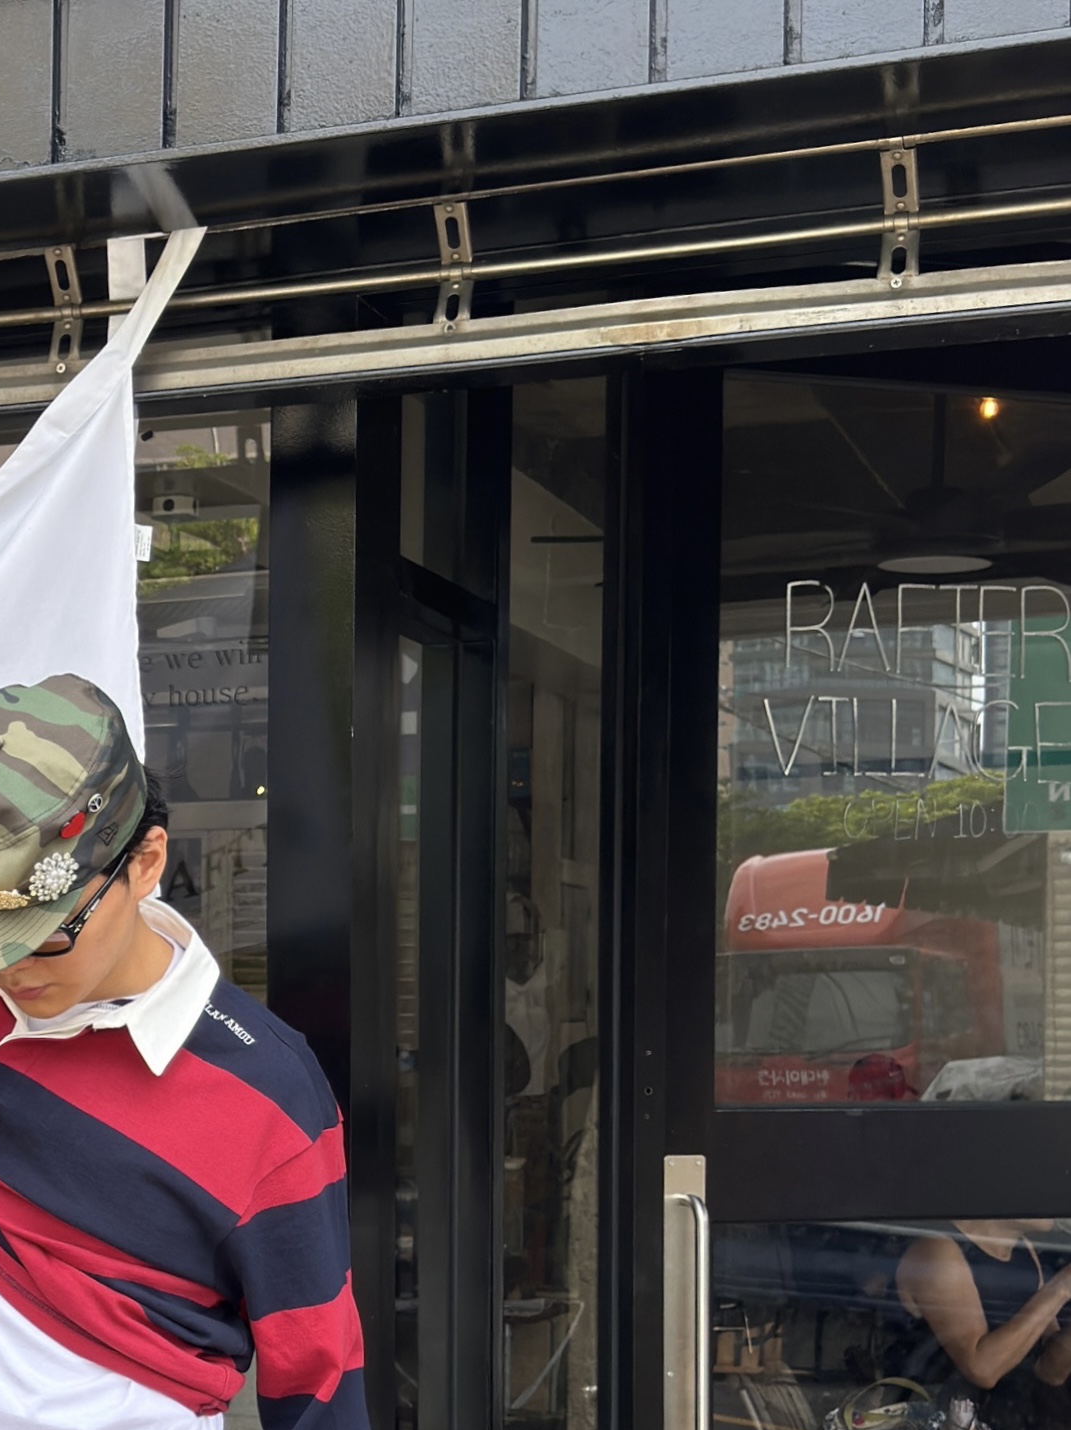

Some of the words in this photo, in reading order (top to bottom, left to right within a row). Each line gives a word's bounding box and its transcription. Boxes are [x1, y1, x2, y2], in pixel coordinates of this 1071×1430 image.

[785, 579, 1071, 683] RAFTER
[762, 695, 1071, 786] VILLAGE
[842, 797, 938, 841] OPEN
